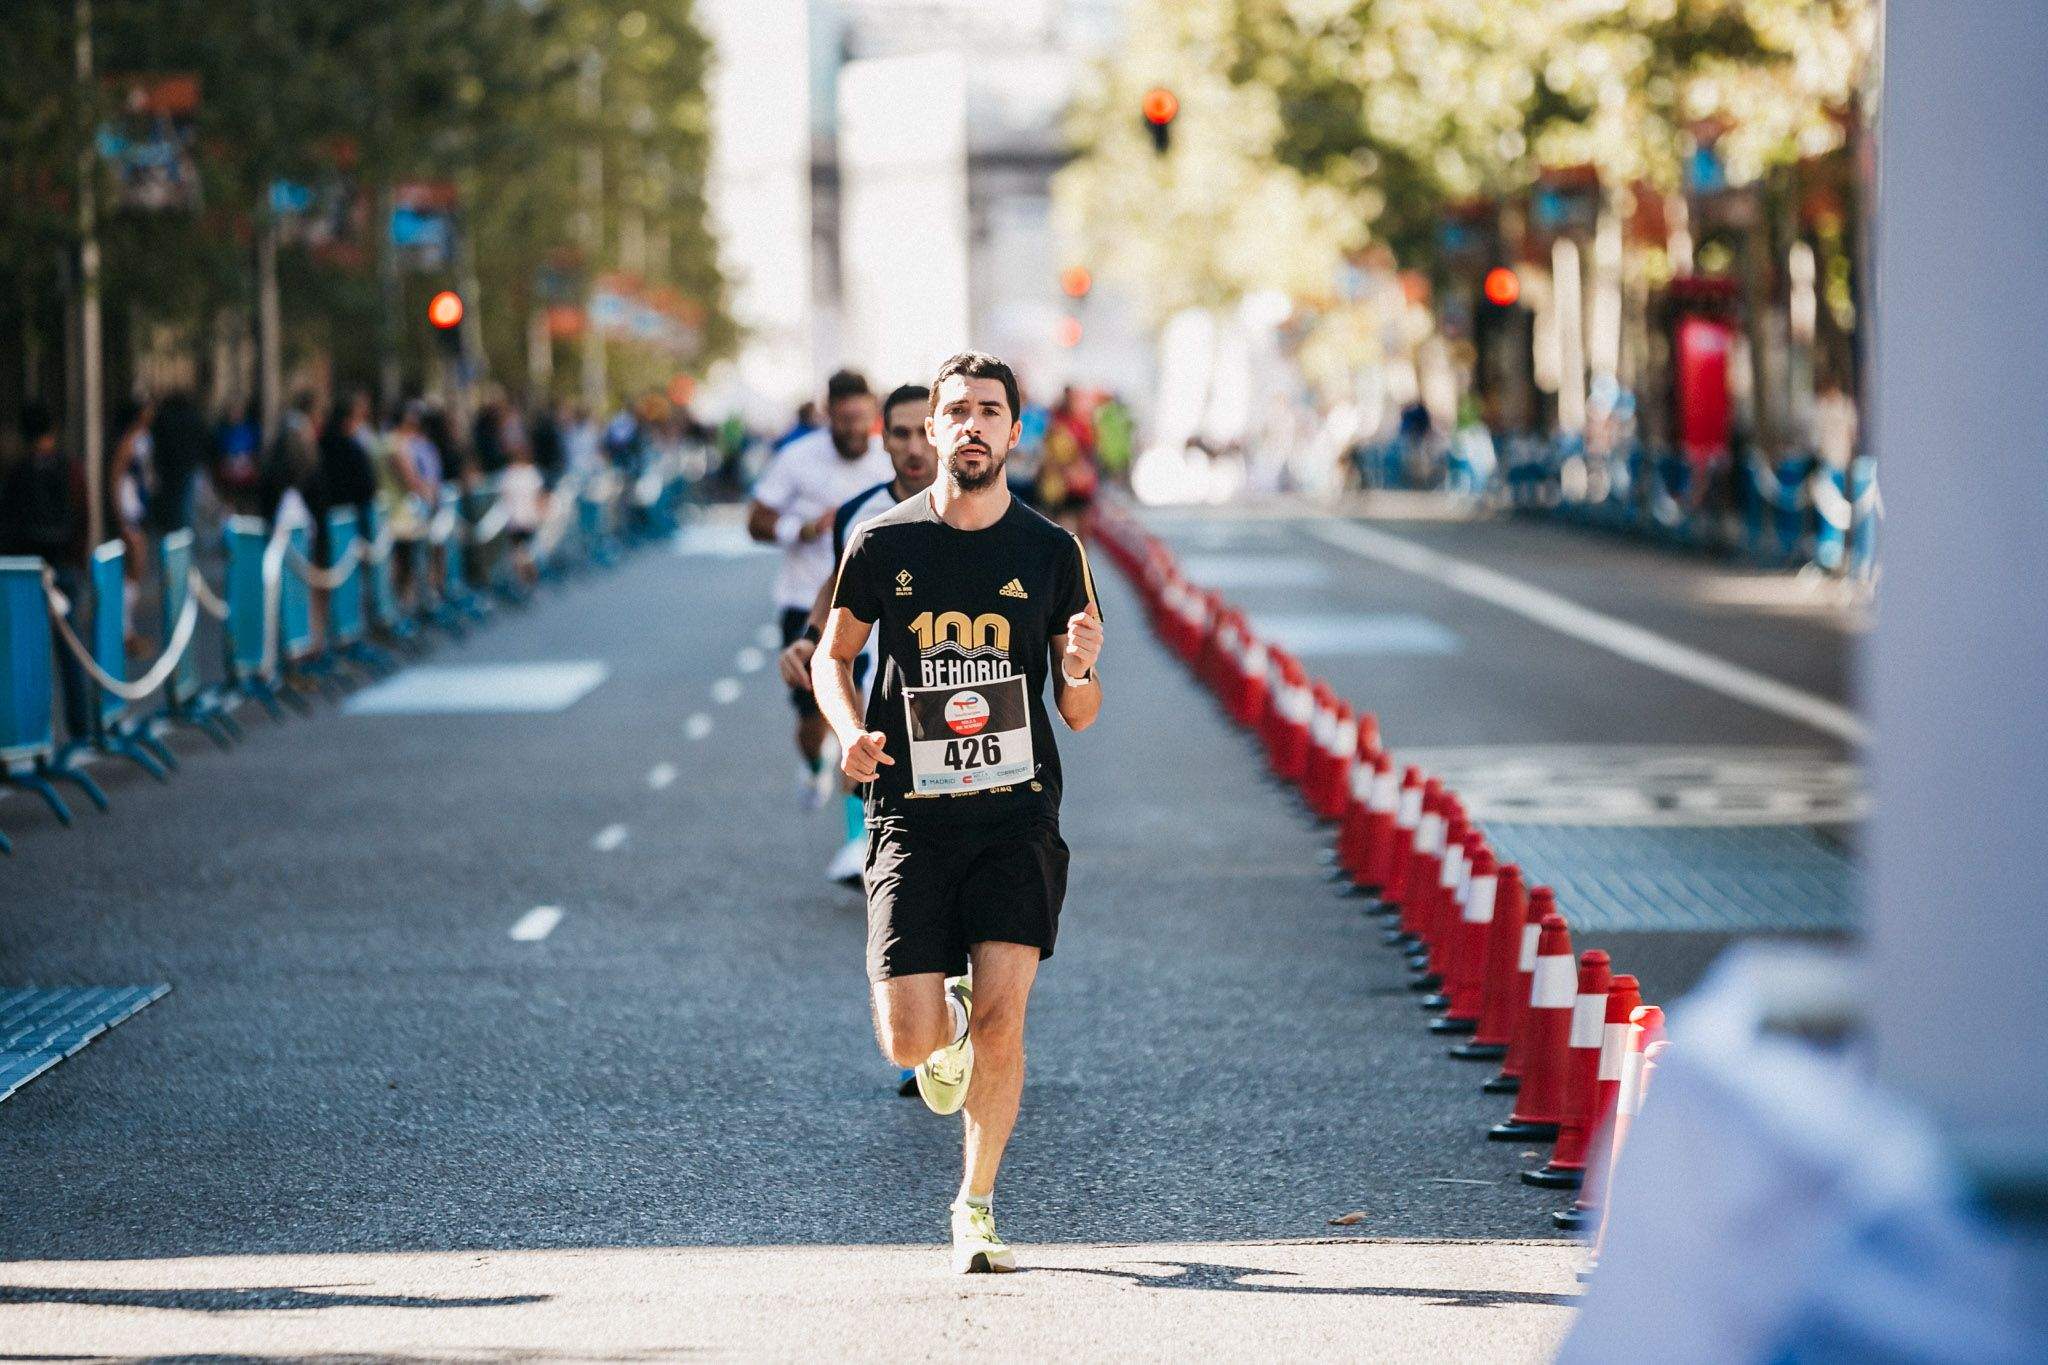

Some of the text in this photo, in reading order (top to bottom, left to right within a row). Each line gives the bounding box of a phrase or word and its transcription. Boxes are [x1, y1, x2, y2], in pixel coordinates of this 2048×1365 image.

[999, 589, 1028, 599] adidas
[908, 611, 1011, 650] 100
[944, 734, 1001, 771] 426
